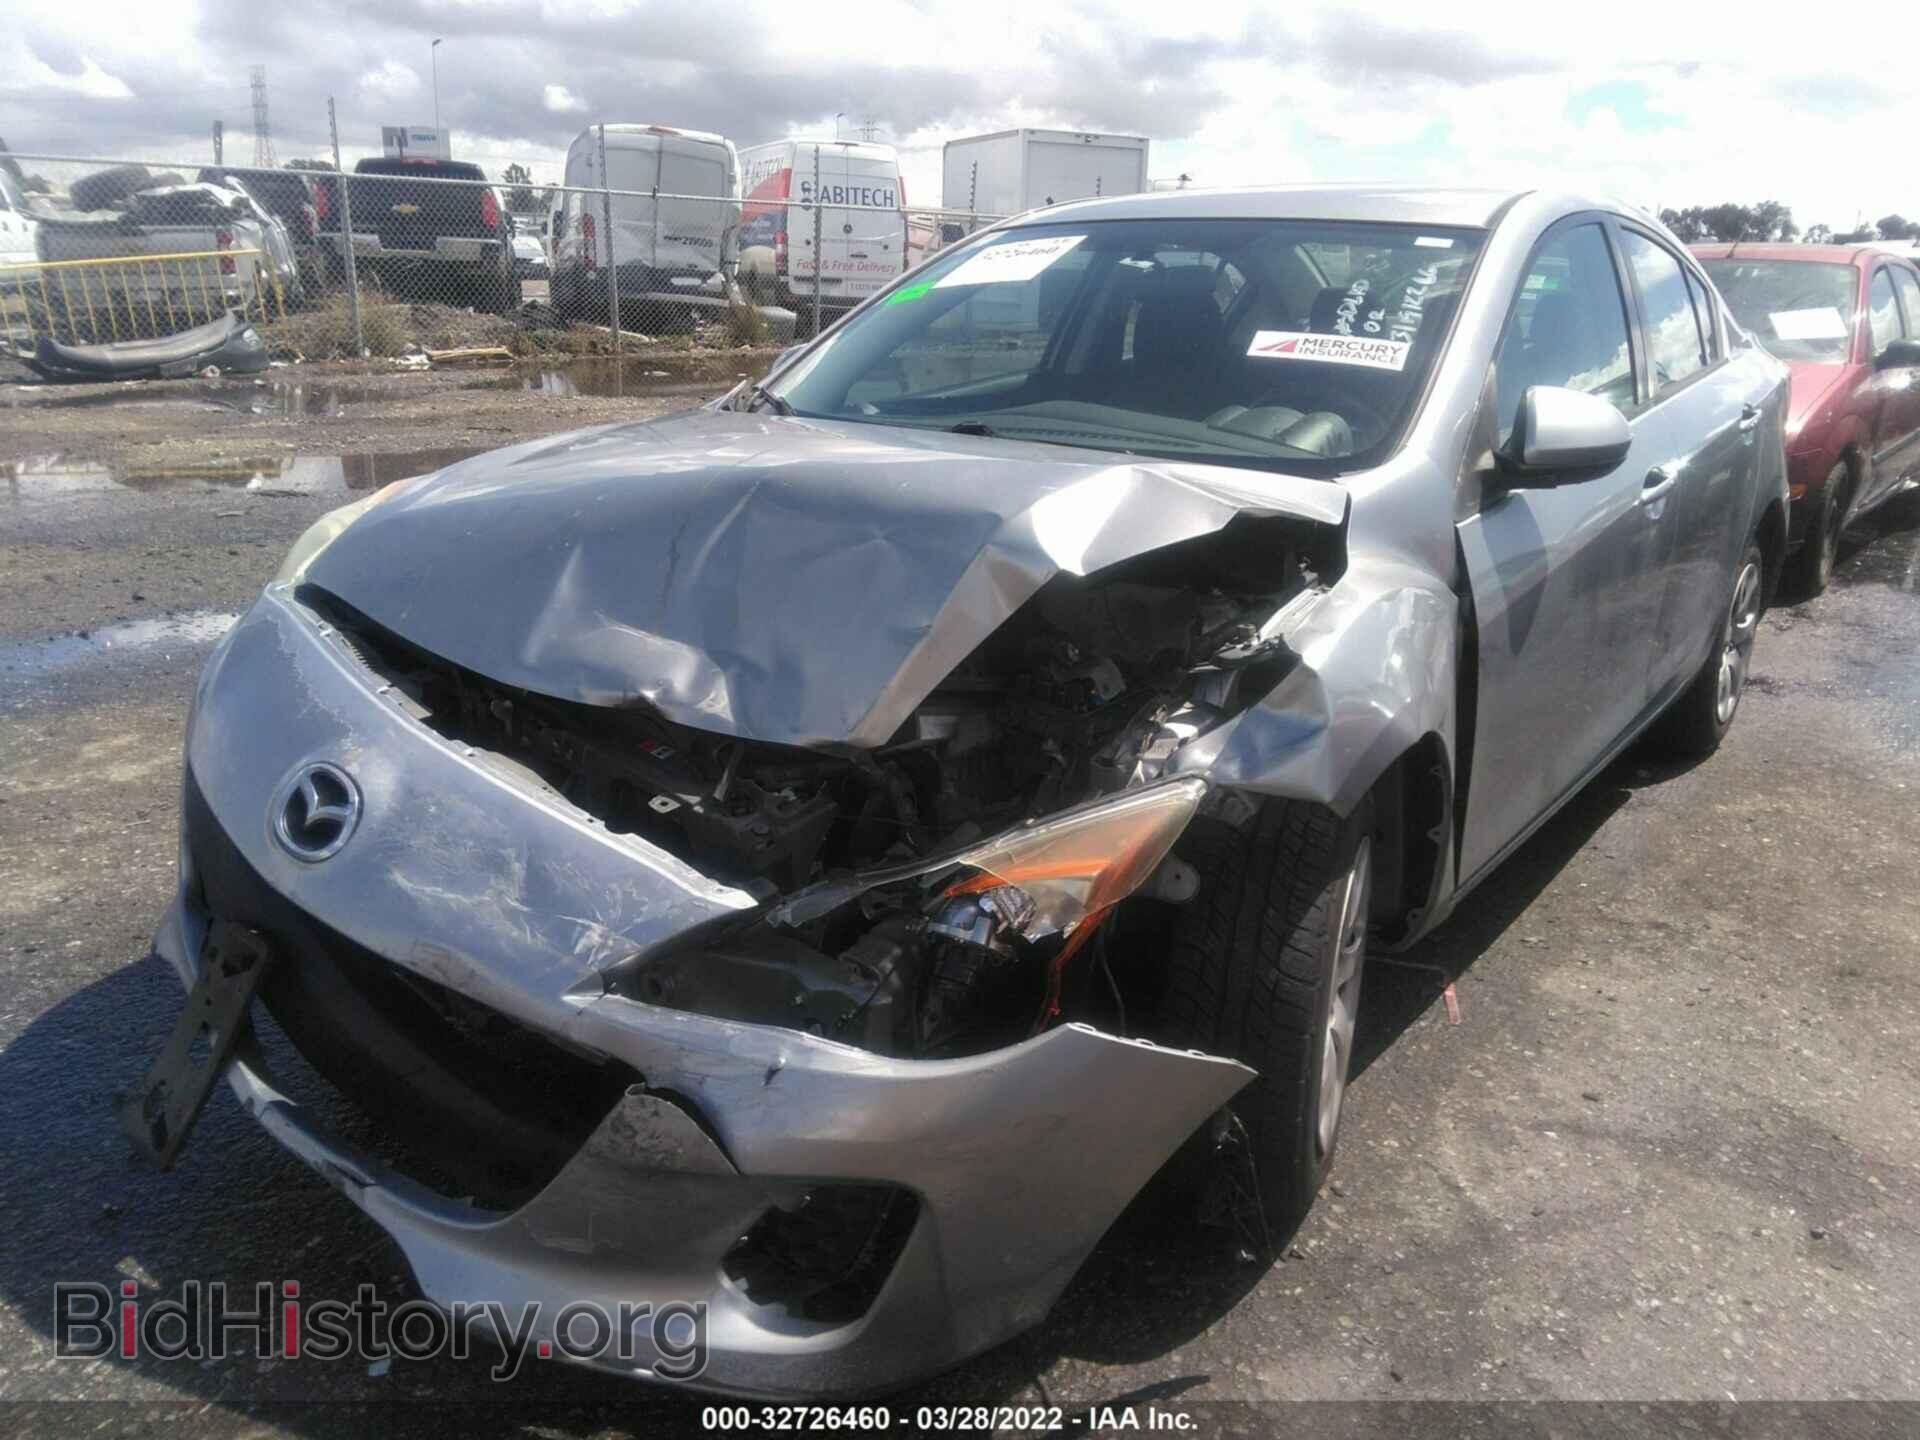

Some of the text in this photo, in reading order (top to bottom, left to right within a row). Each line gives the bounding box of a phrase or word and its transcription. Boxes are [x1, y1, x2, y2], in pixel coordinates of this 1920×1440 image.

[796, 259, 819, 273] Fas
[832, 260, 855, 272] Free
[857, 261, 897, 275] Delivery
[1301, 337, 1404, 355] MERCURY
[1299, 346, 1400, 365] INSURANCE
